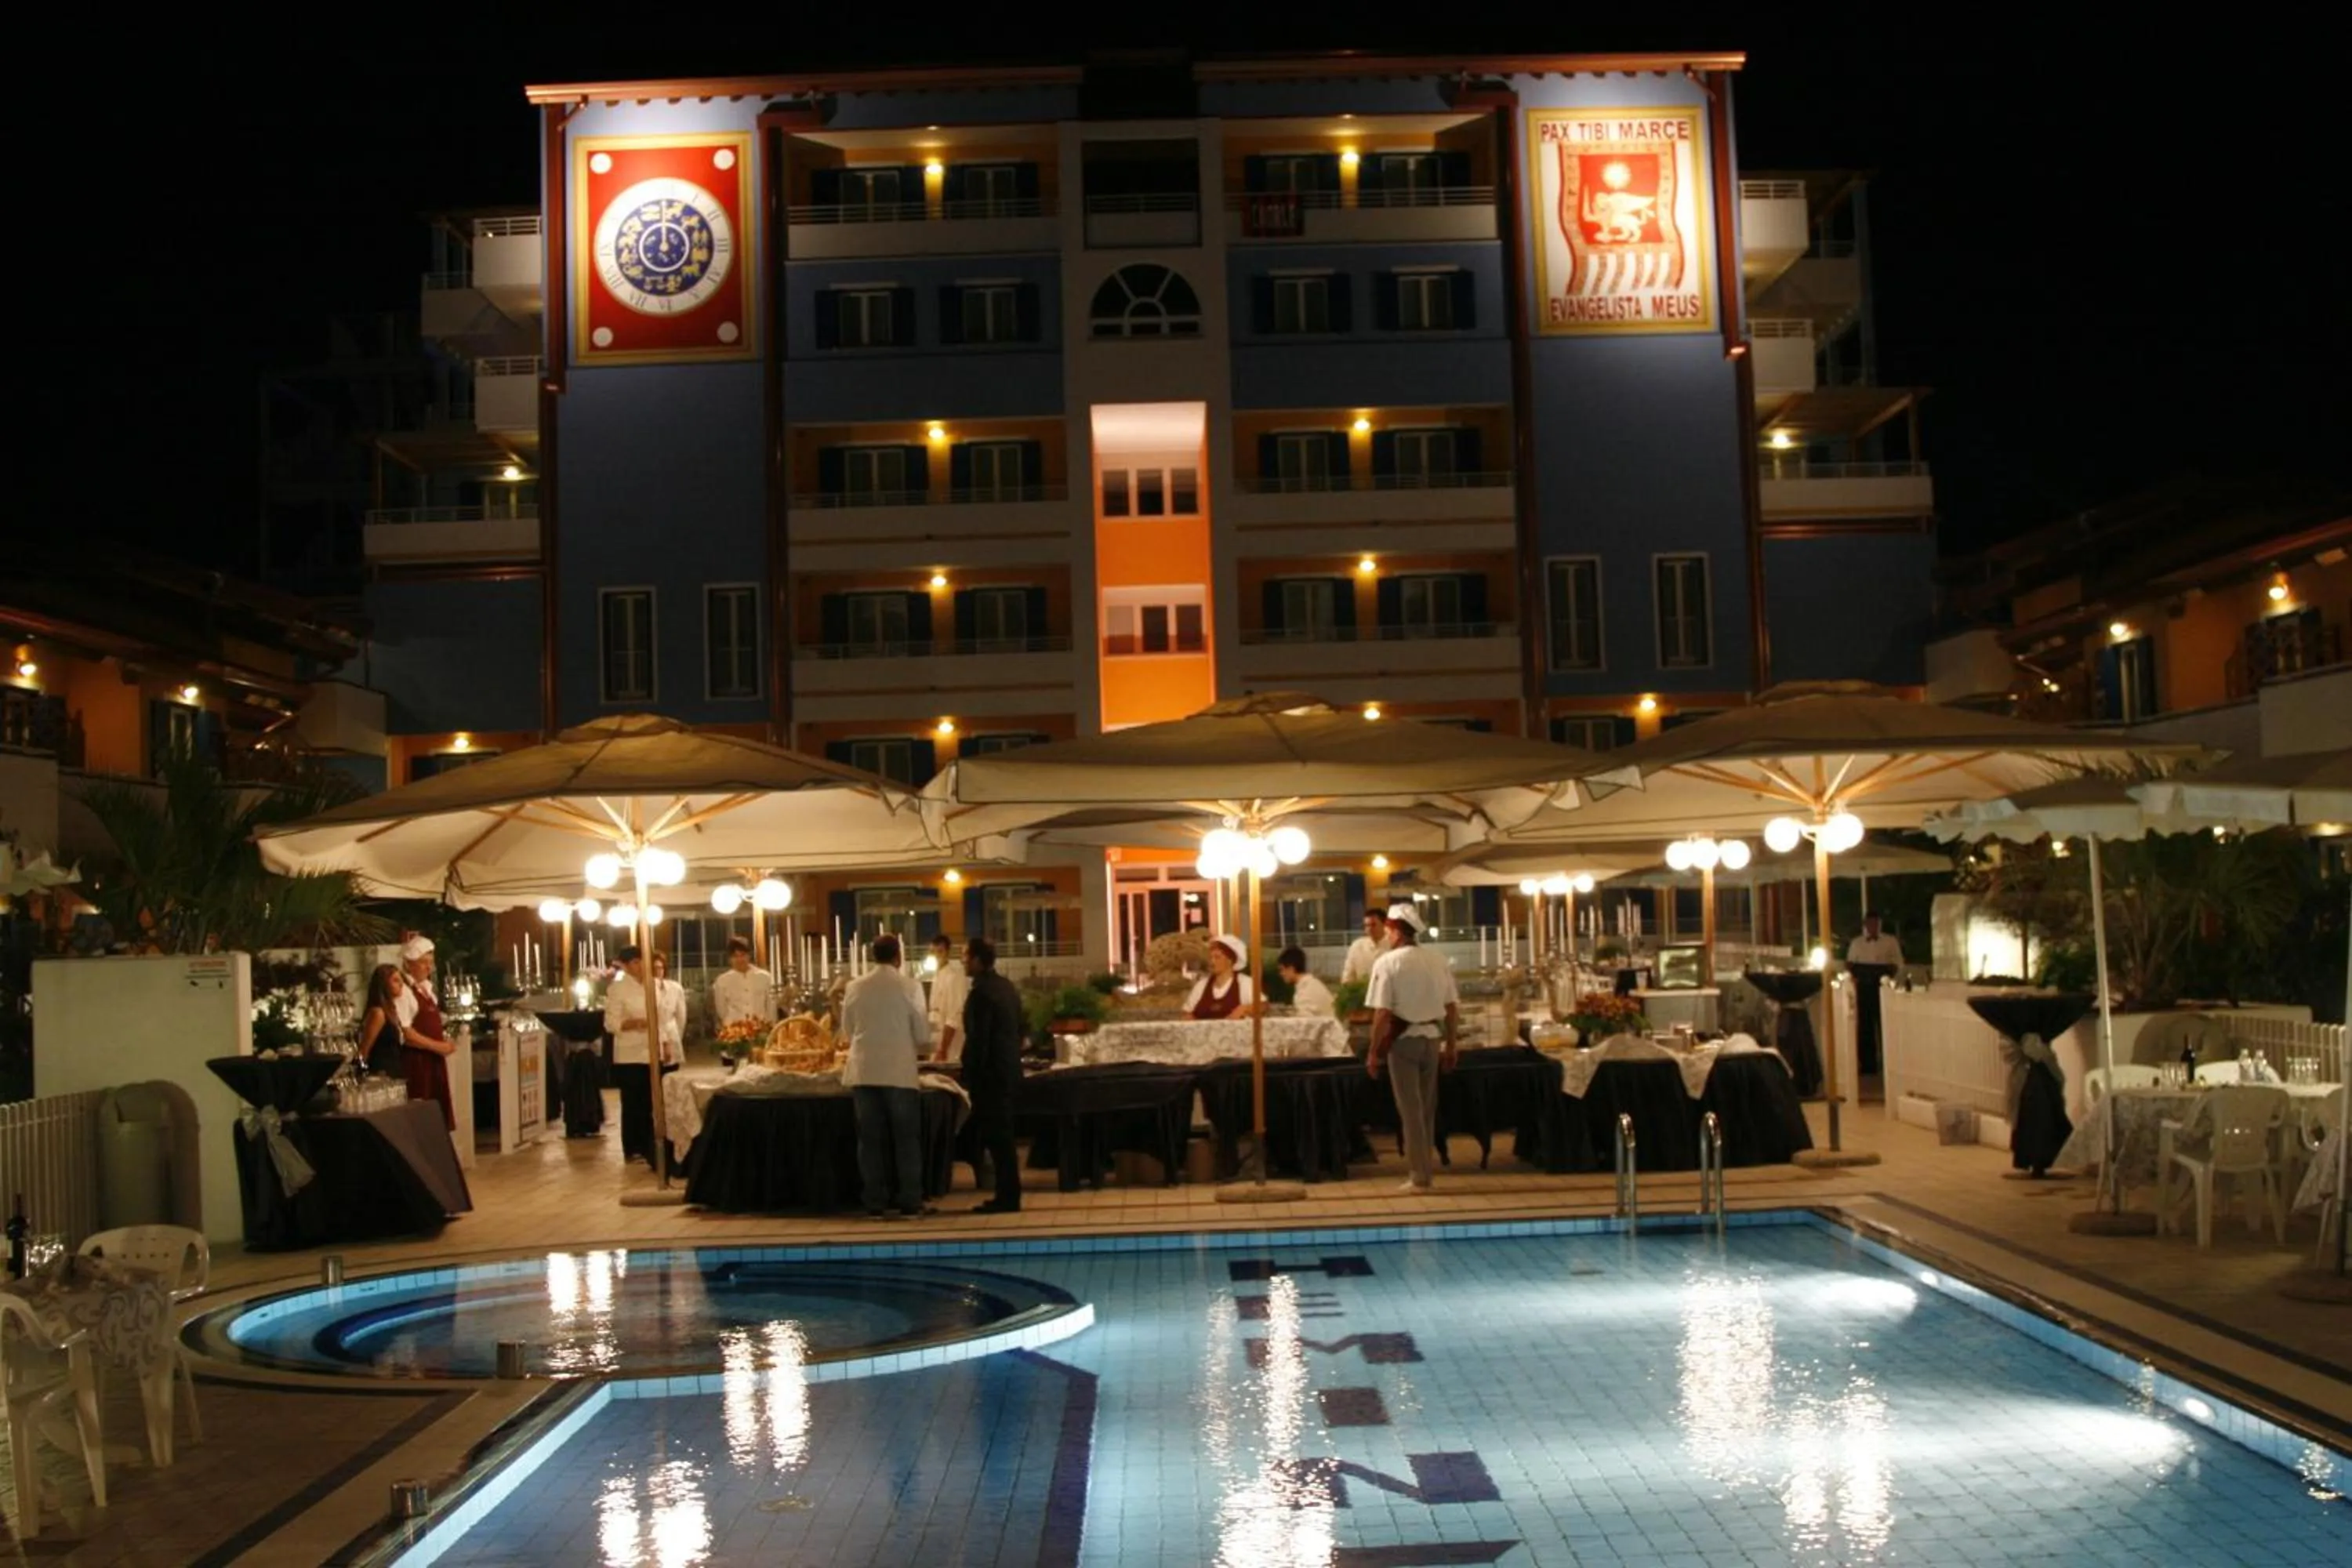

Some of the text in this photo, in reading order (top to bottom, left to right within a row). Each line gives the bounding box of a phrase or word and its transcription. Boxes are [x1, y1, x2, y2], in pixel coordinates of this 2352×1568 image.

[1541, 121, 1690, 142] PAX TIBI MARCE
[1551, 294, 1700, 322] EVANGELISTA MEUS
